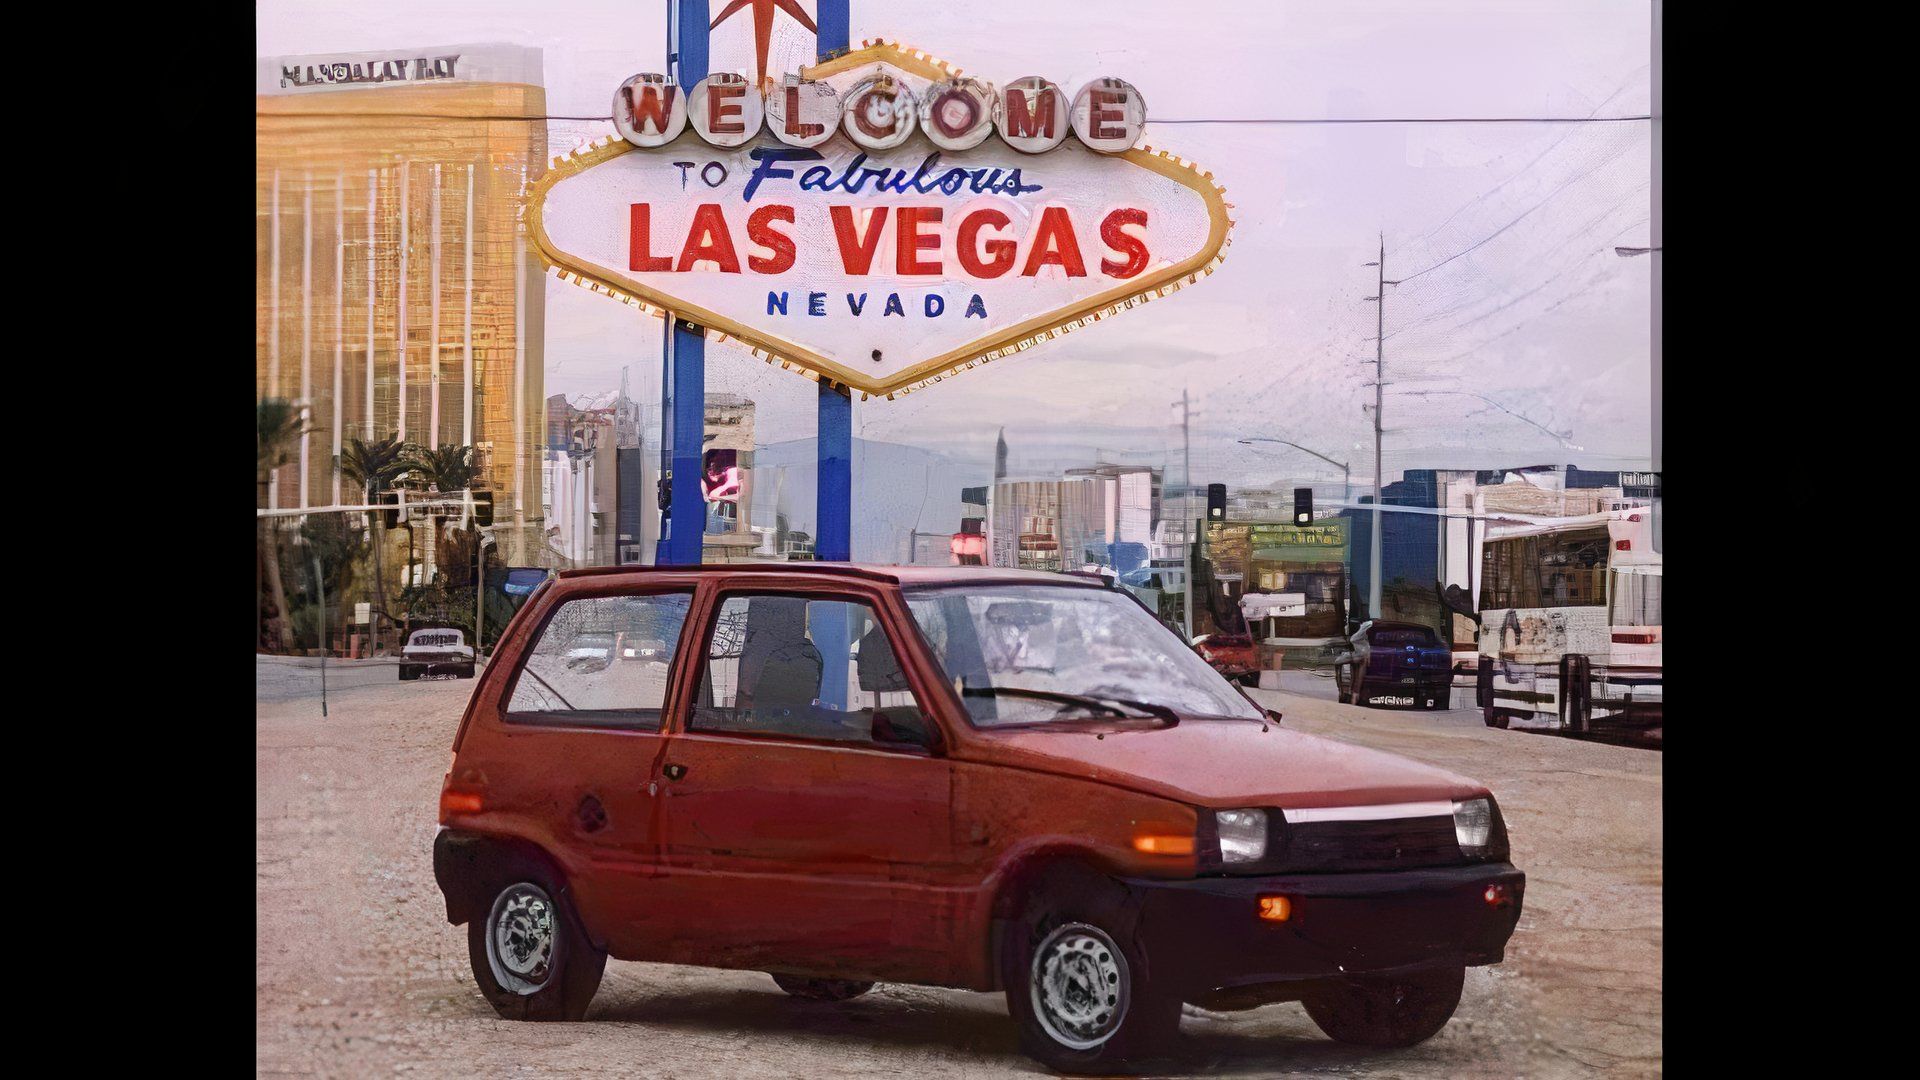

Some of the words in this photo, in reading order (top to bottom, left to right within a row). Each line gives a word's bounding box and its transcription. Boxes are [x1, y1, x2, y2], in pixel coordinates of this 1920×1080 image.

[622, 77, 1127, 140] WELCOME
[673, 161, 728, 191] TO
[742, 147, 1043, 202] Fabulous
[629, 203, 797, 275] LAS
[830, 204, 1150, 280] VEGAS
[767, 291, 988, 318] NEVADA
